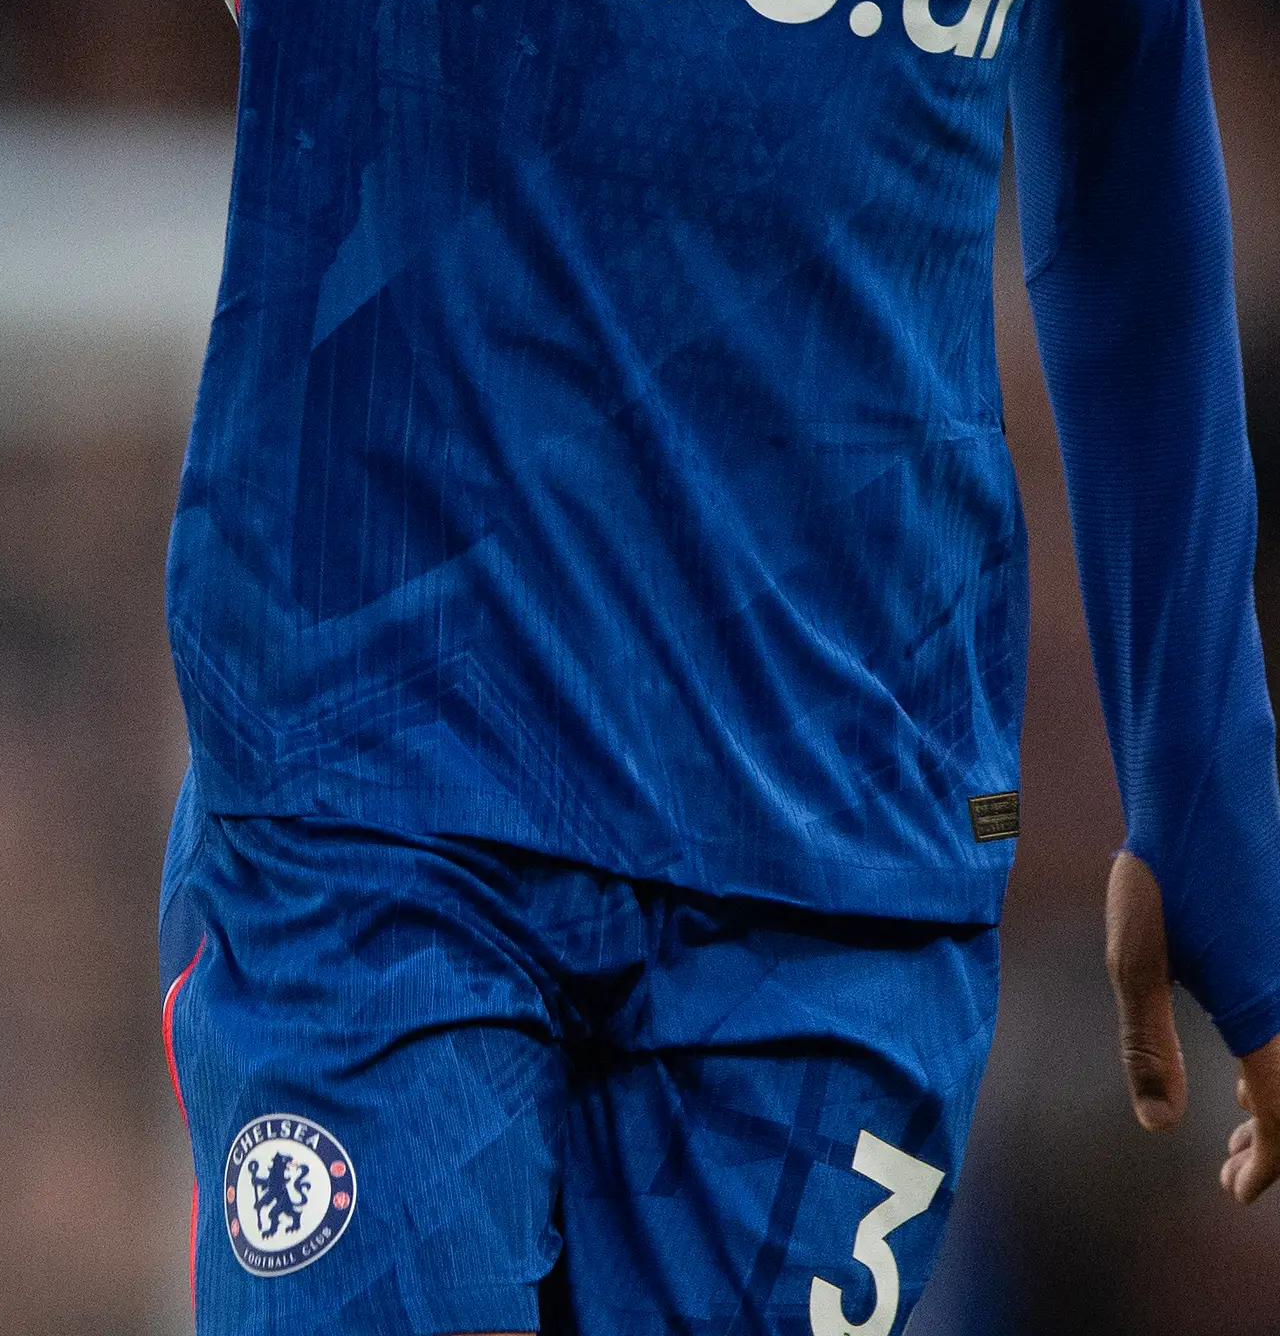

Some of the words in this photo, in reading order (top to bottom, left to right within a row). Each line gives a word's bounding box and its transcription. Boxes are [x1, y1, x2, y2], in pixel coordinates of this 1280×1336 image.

[232, 1120, 320, 1165] CHELSEA
[243, 1248, 296, 1268] FOOTBALL
[302, 1226, 333, 1256] CLUB
[809, 1128, 947, 1336] 3
